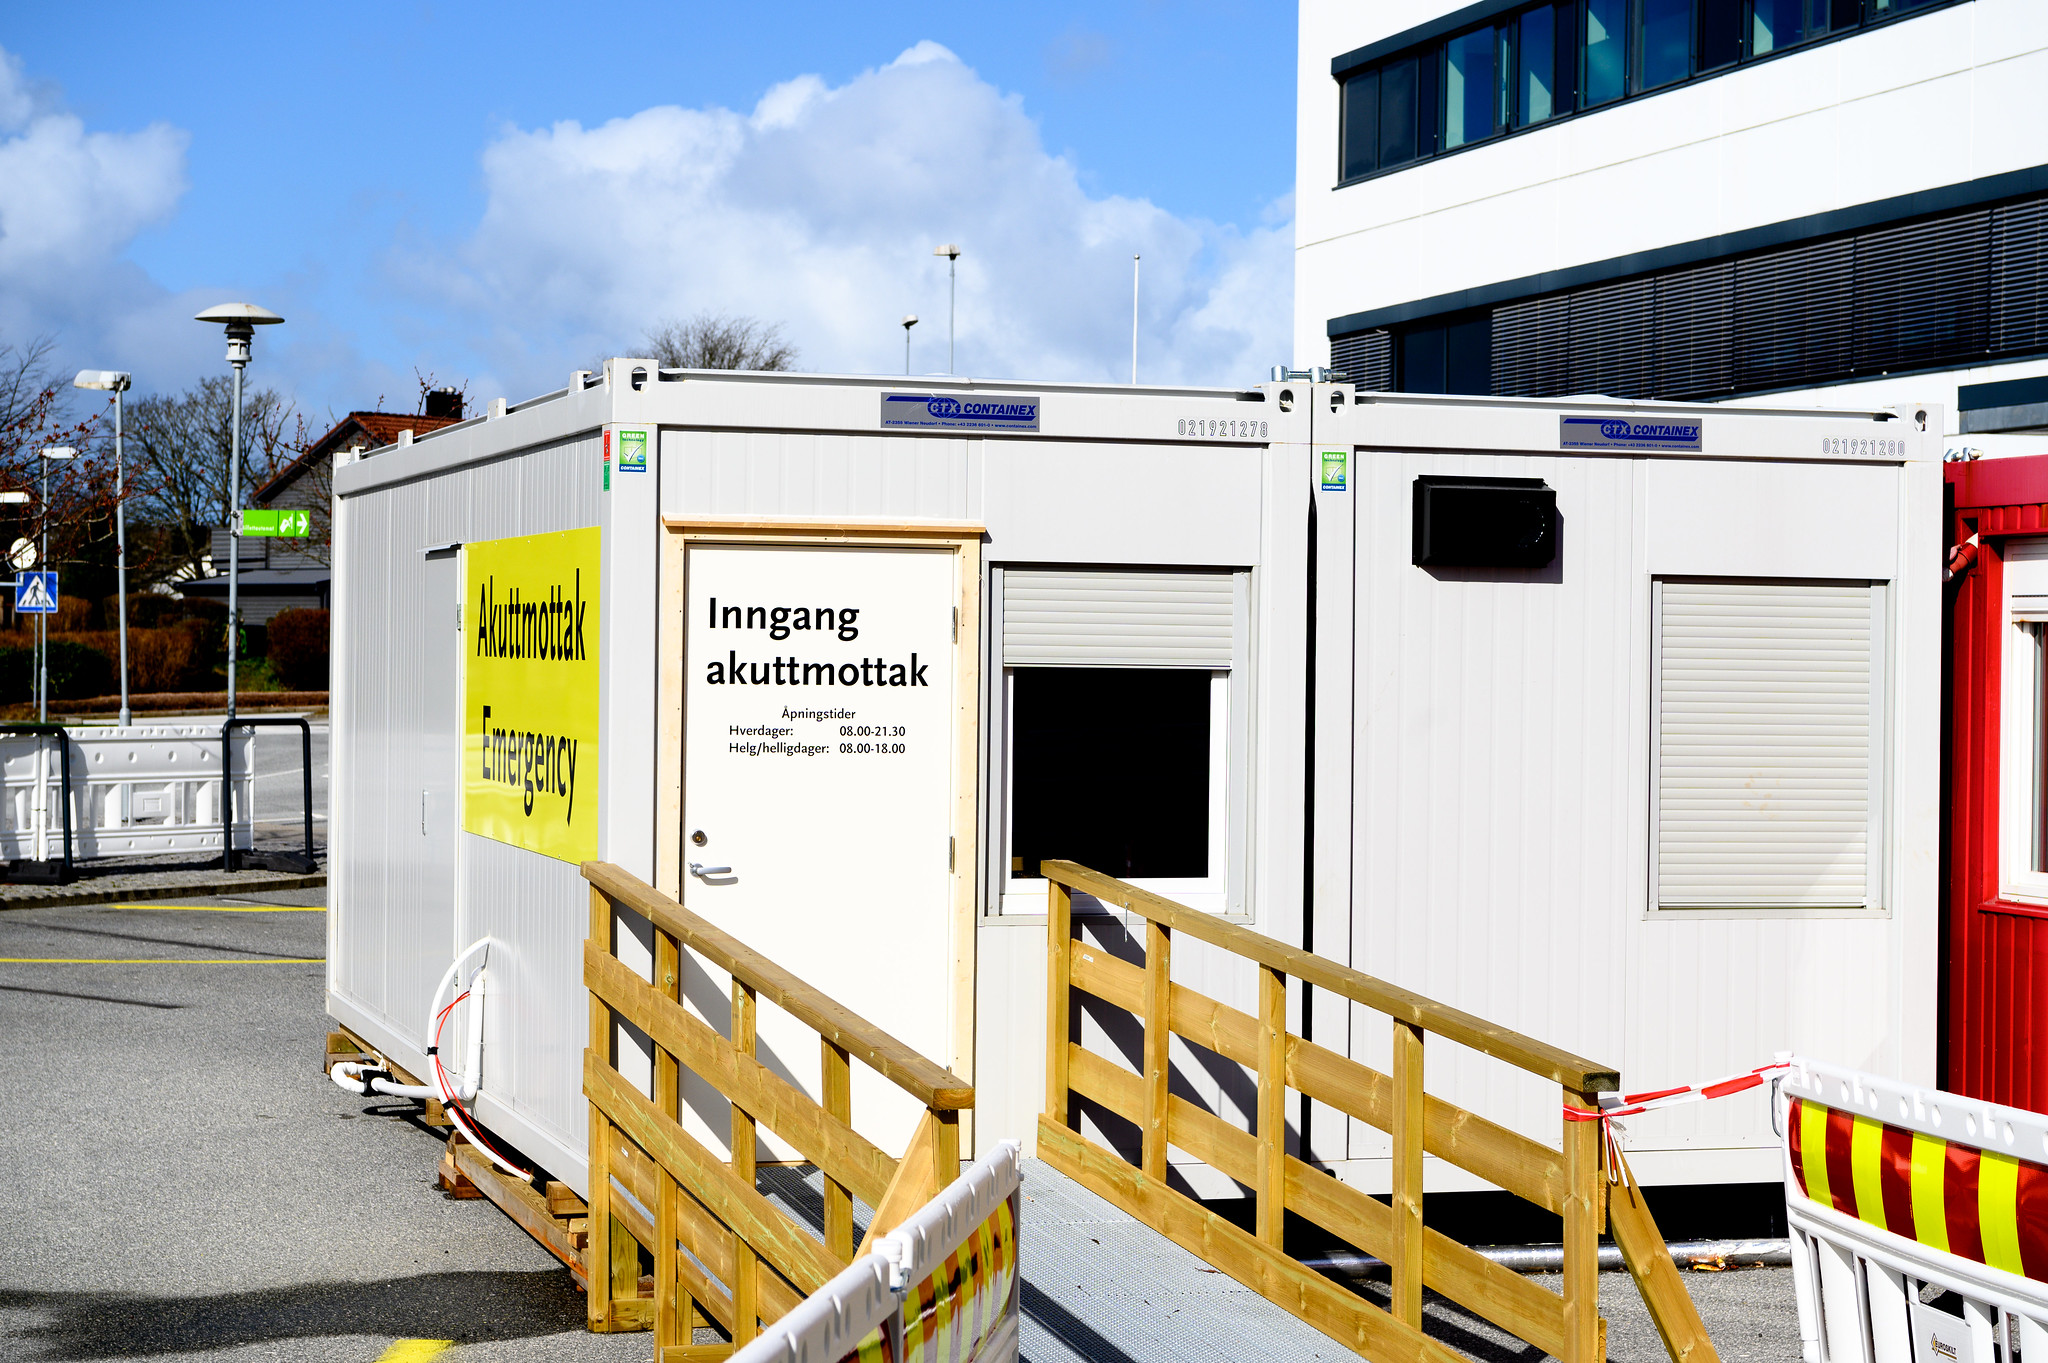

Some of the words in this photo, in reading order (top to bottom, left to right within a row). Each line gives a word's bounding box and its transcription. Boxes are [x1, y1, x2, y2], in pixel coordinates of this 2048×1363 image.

[930, 403, 958, 413] CTX
[963, 403, 1036, 416] CONTAINEX
[1178, 419, 1268, 438] 021921278
[1603, 424, 1628, 435] CTX
[1633, 424, 1699, 437] CONTAINEX
[1822, 438, 1905, 456] 021921280
[477, 568, 586, 661] Akuttmottak
[709, 597, 860, 642] Inngang
[706, 650, 929, 687] akuttmottak
[781, 705, 856, 722] Åpningstider
[729, 725, 794, 740] Hverdager:
[839, 726, 906, 737] 08.00-21.30
[729, 742, 830, 757] Helg/helligdager:
[839, 742, 906, 754] 08.00-18.00
[482, 705, 577, 827] Emergency
